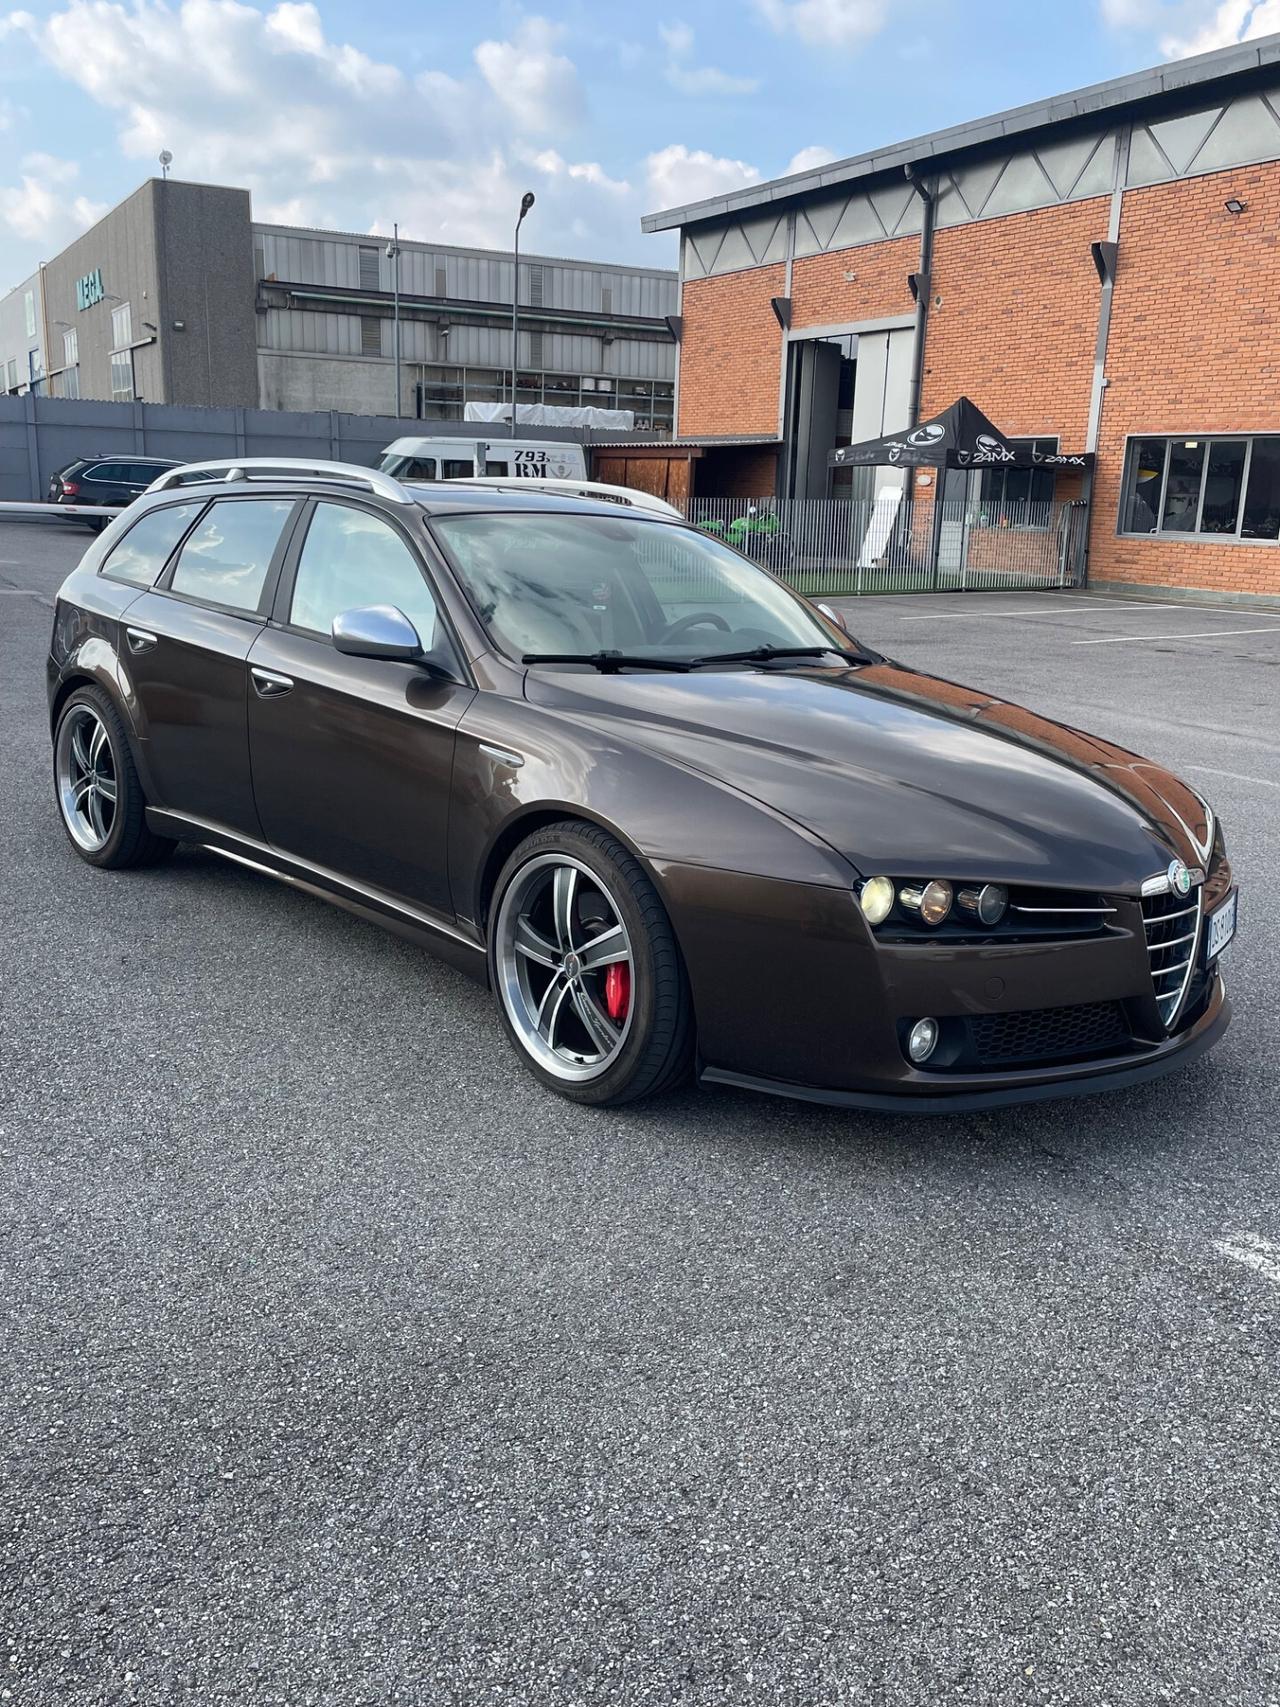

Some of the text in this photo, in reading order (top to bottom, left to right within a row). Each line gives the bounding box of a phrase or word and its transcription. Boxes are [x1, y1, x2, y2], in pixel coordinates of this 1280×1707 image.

[76, 268, 104, 312] MEGA
[972, 451, 1016, 463] 24MX
[1045, 454, 1086, 466] 24MX
[515, 462, 547, 478] RM
